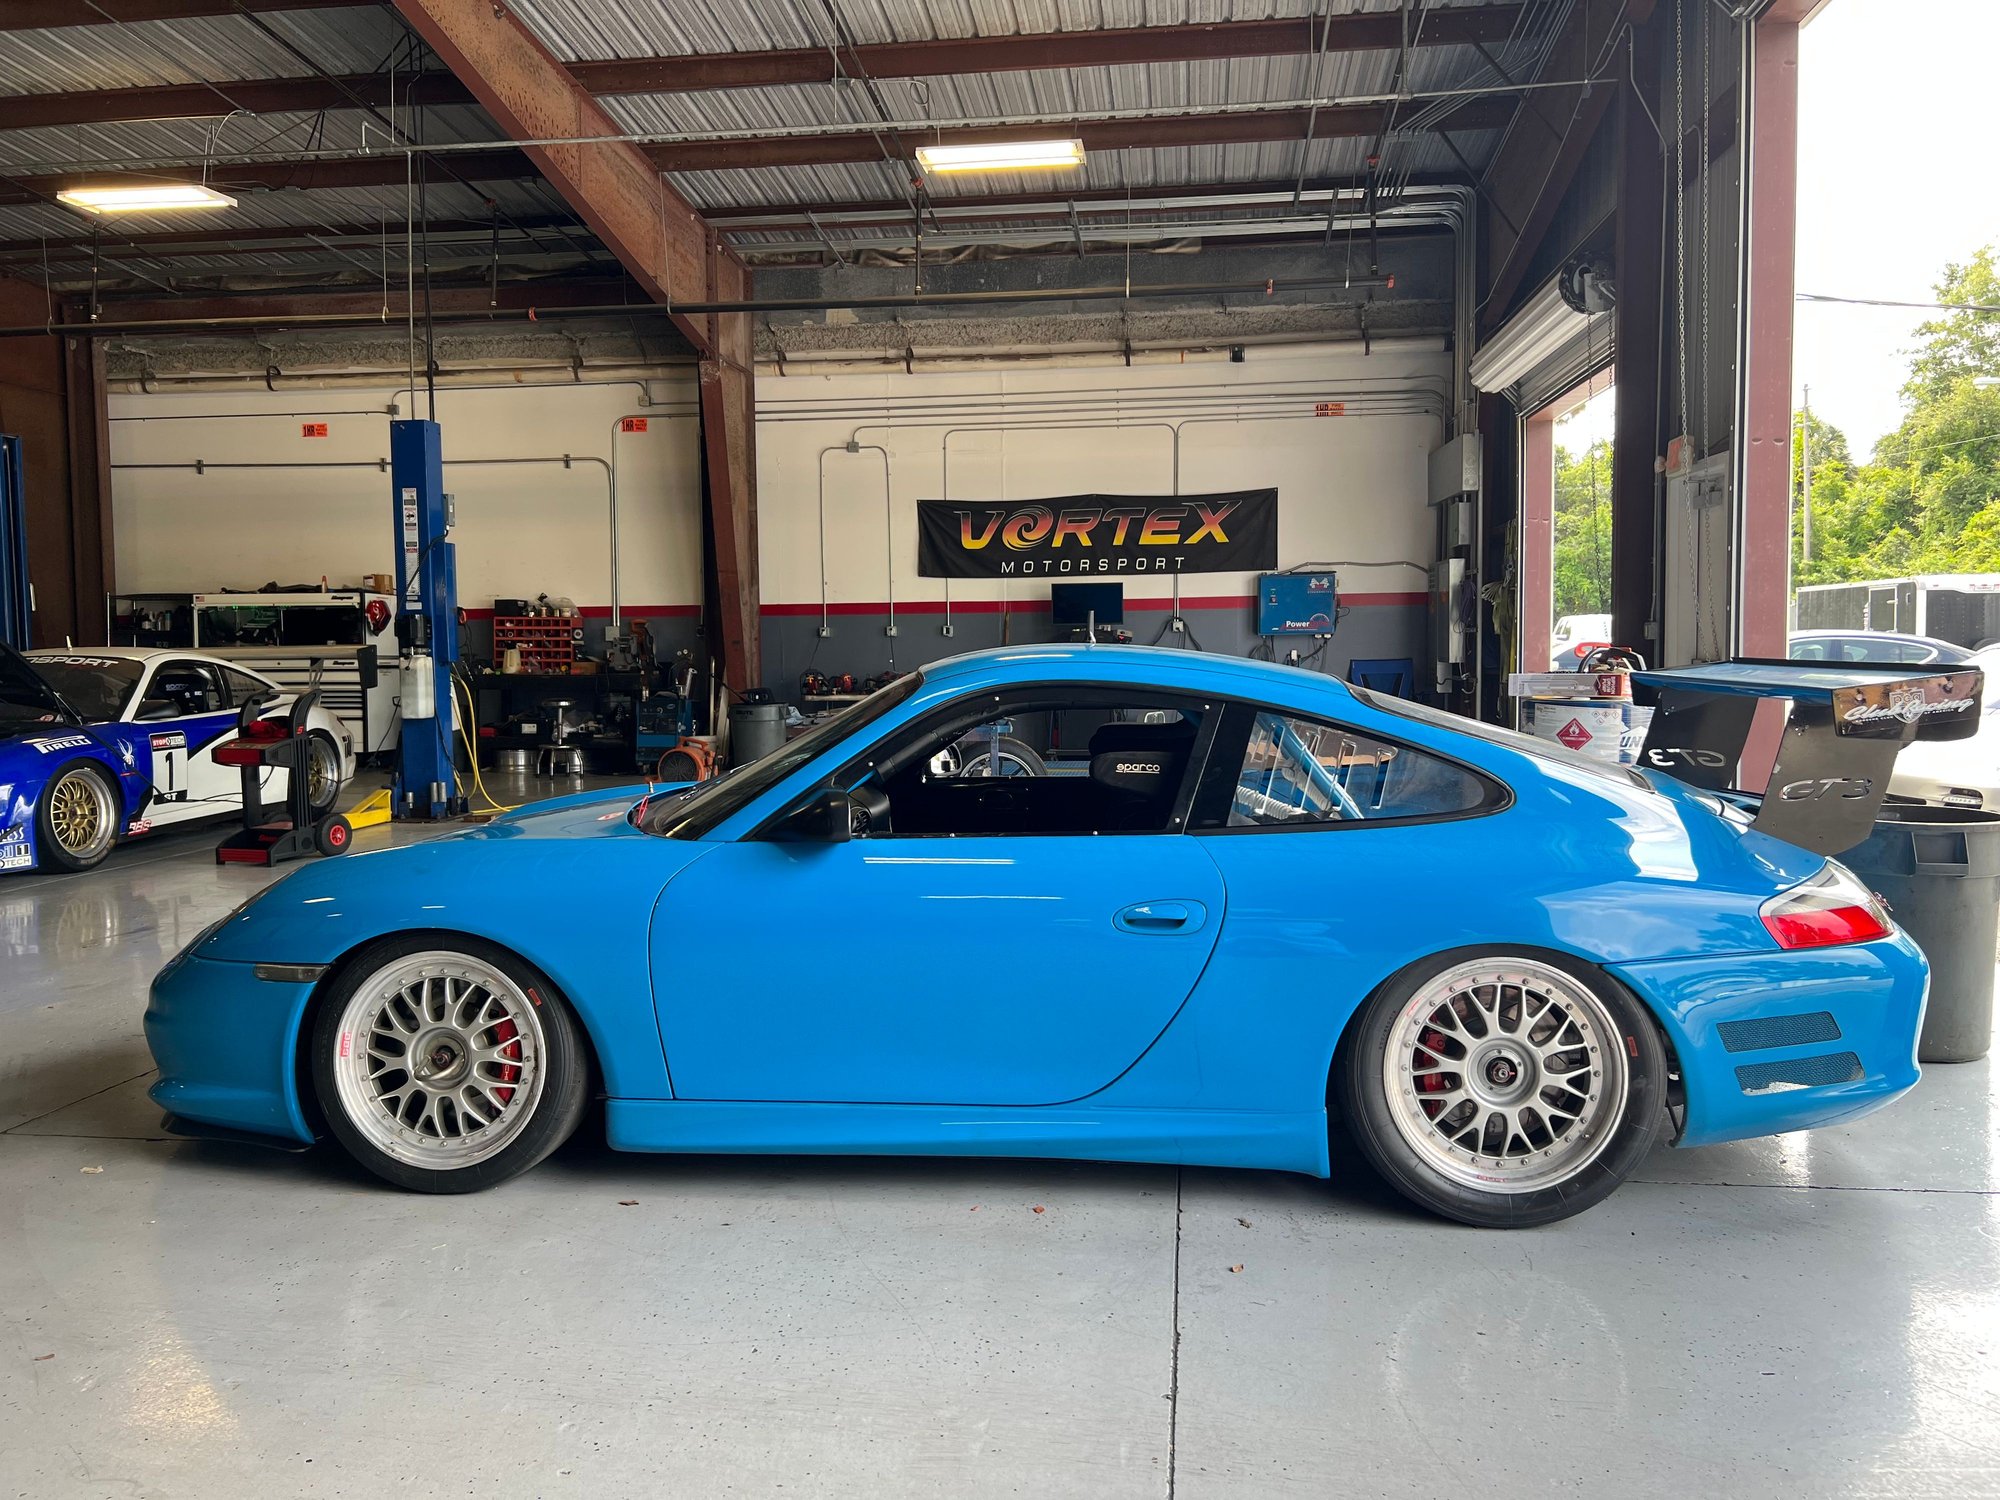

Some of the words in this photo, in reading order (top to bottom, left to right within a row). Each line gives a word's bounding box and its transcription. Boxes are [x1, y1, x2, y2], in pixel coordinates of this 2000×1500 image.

[953, 500, 1242, 551] VORTEX
[1001, 557, 1185, 573] MOTORSPORT
[32, 735, 92, 754] PIRELLI
[165, 751, 174, 791] 1
[1779, 779, 1873, 802] GT3
